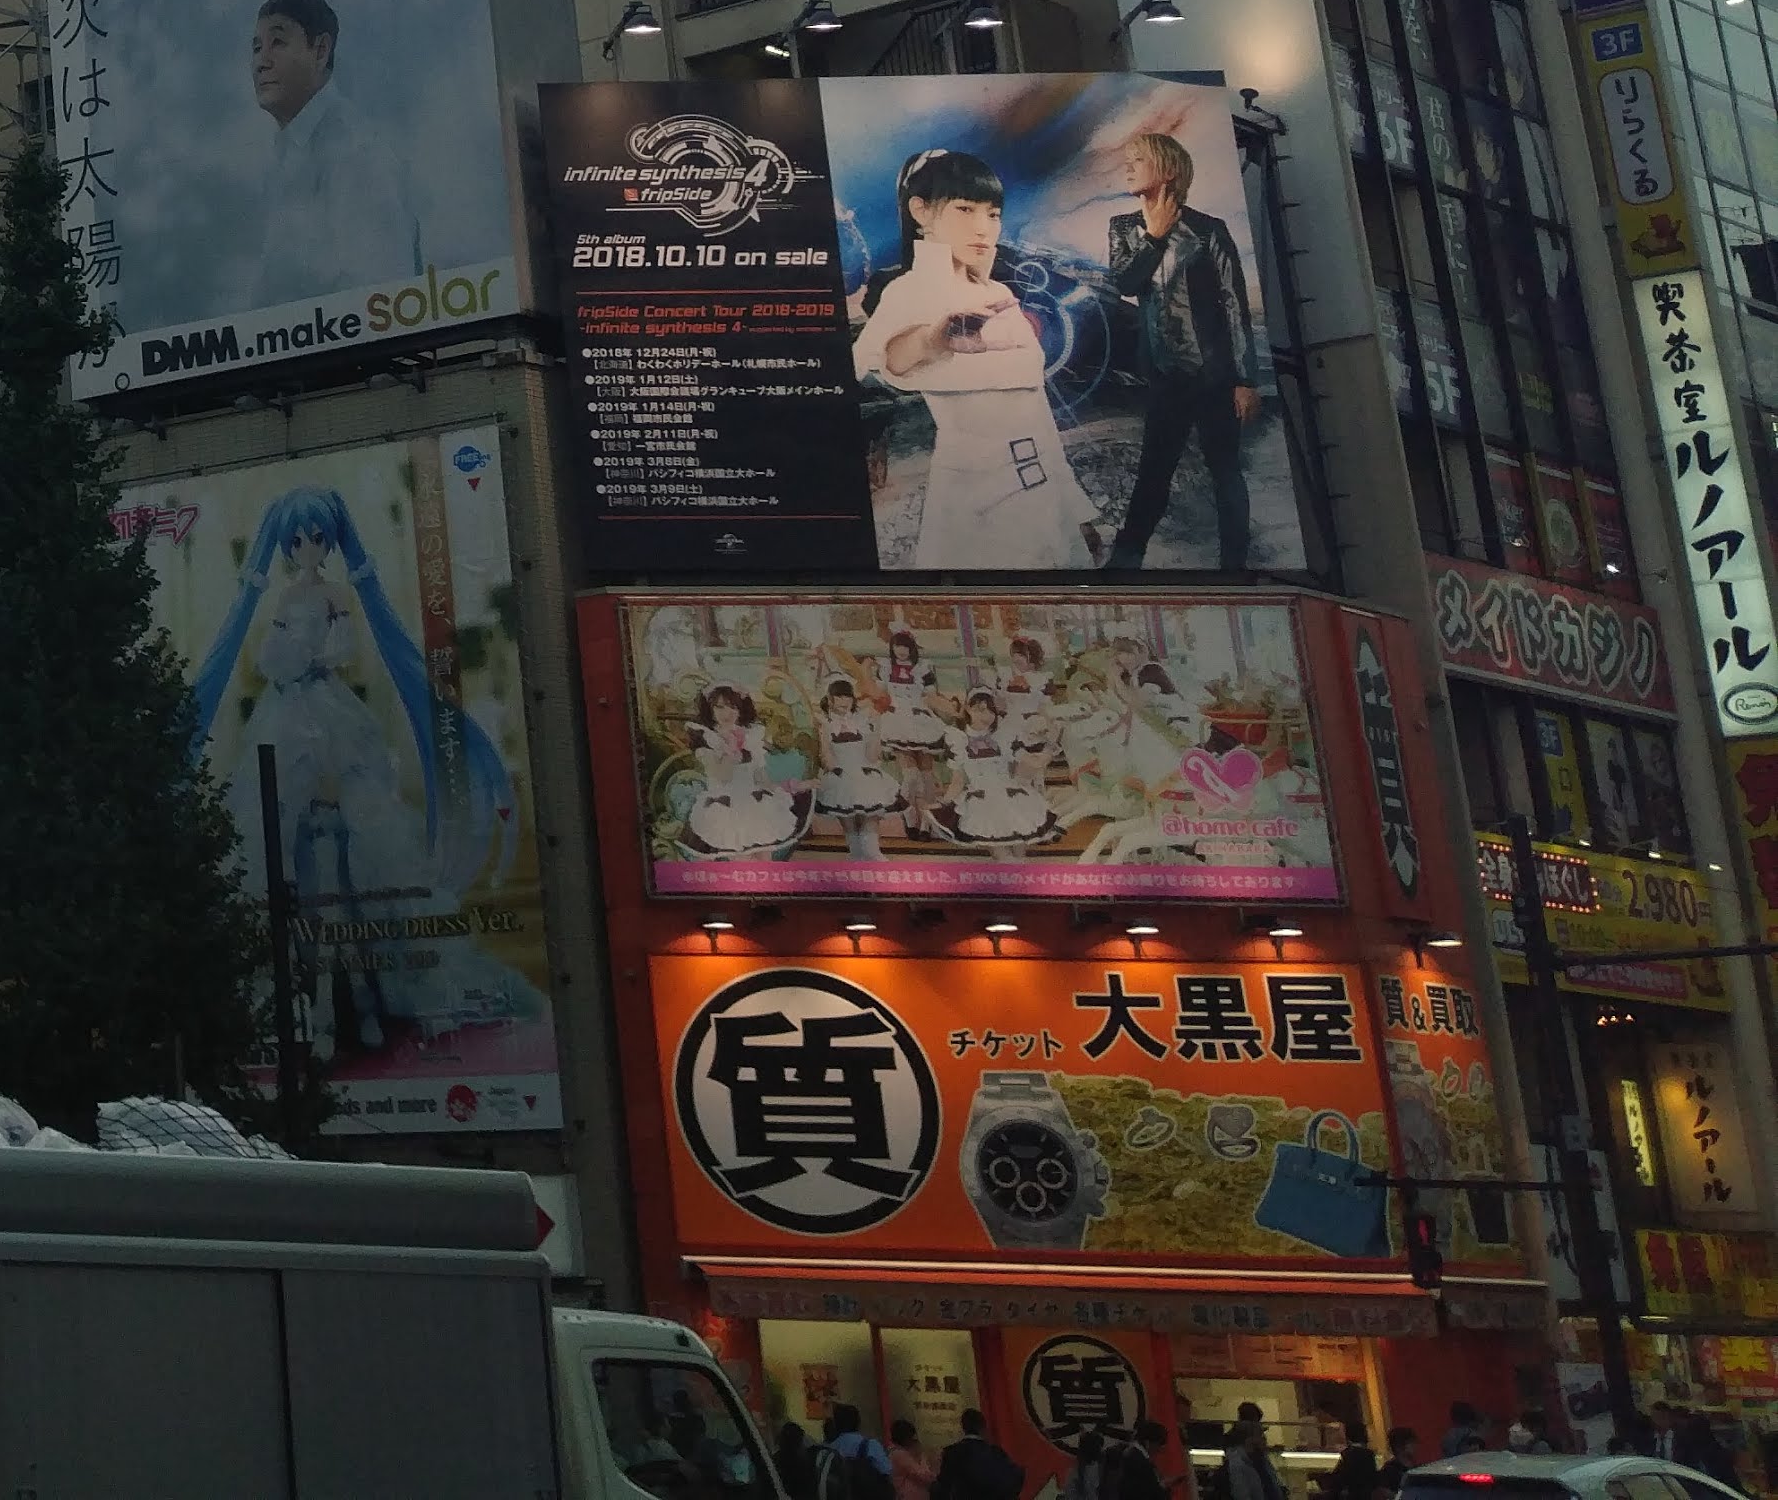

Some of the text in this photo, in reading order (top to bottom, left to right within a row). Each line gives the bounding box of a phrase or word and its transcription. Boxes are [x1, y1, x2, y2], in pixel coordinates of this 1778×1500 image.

[1597, 28, 1637, 58] 3F
[1613, 75, 1661, 198] りらくる
[564, 165, 635, 183] infinite
[638, 164, 746, 185] synthesis
[640, 187, 713, 204] fripSide
[577, 234, 646, 245] 5th album
[573, 244, 828, 269] 2018.10.10 on sale
[141, 262, 500, 377] DMM.make solar
[577, 304, 835, 319] fripSide Concert Tour 2018-2019
[644, 322, 727, 337] synthesis
[1436, 569, 1657, 698] メイドカジノ
[1162, 816, 1299, 837] @home cafe
[949, 970, 1364, 1065] チケット 大黒屋
[1380, 975, 1480, 1038] 質&買取
[706, 1008, 900, 1201] 質
[1685, 1073, 1733, 1204] ルノアール
[906, 1376, 961, 1394] 大黒屋
